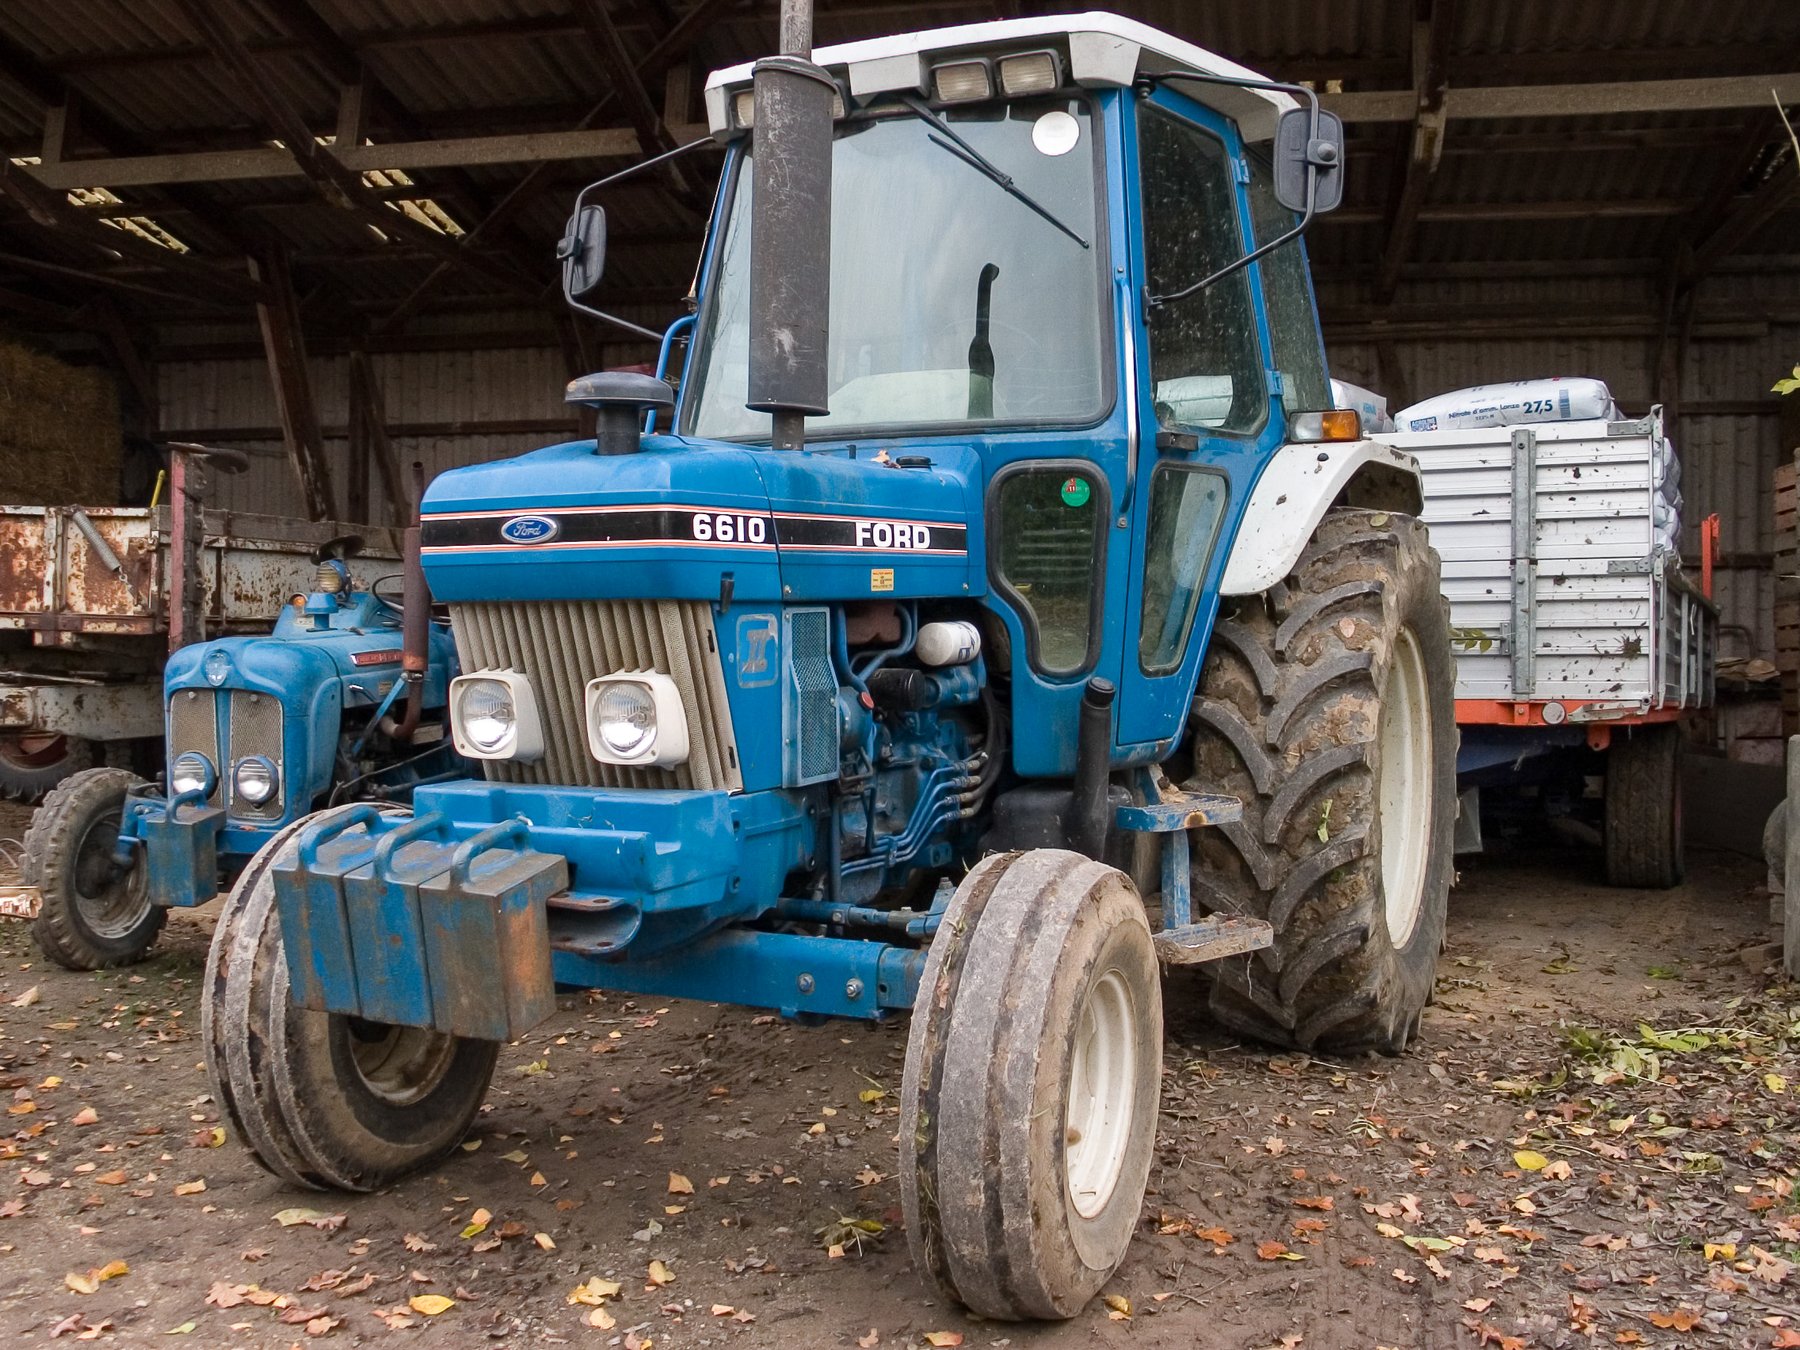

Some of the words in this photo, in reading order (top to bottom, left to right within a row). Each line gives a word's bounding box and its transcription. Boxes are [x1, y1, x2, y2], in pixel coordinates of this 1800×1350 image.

[1523, 400, 1553, 415] 27,5
[513, 521, 542, 536] Ford
[693, 513, 766, 543] 6610
[855, 521, 931, 549] FORD
